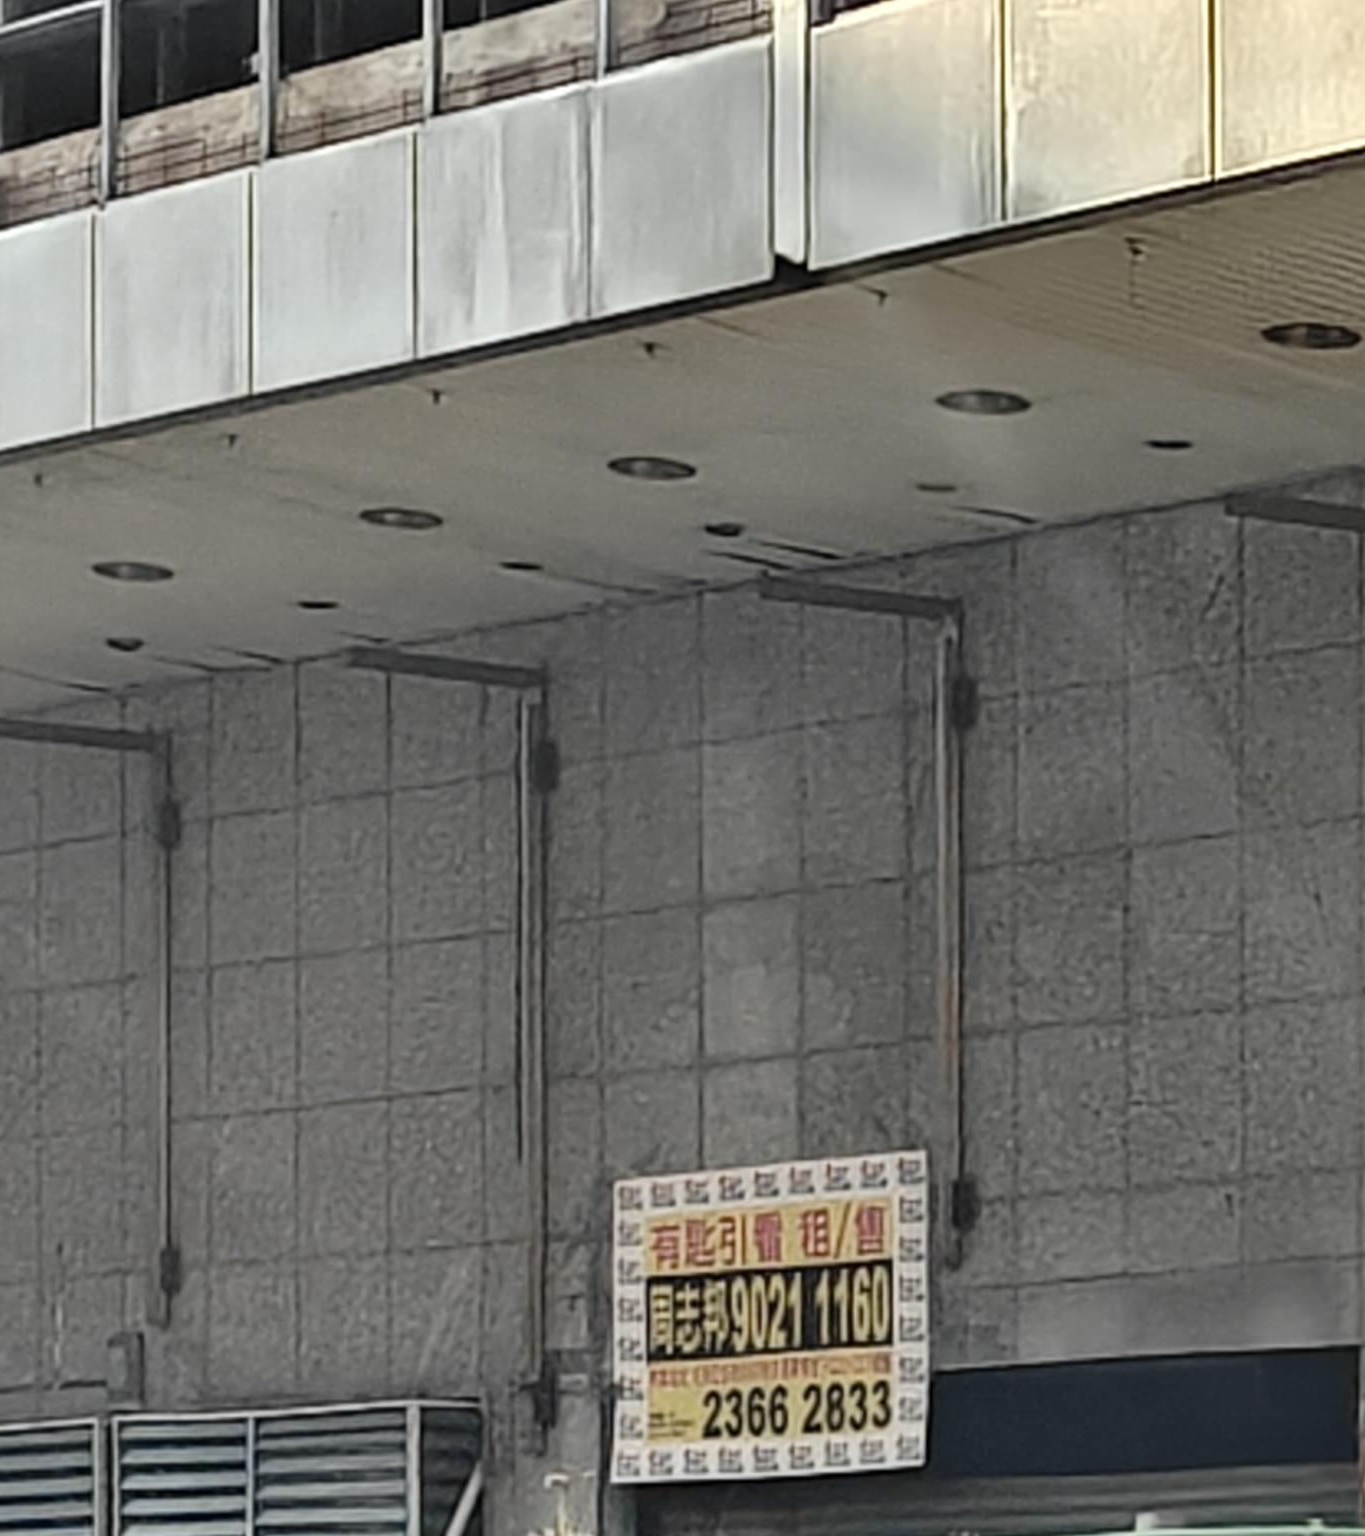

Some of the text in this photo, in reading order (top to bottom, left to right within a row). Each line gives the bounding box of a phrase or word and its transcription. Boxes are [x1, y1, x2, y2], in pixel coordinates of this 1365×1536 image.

[815, 1263, 891, 1347] 1160
[701, 1384, 790, 1440] 2366
[802, 1379, 893, 1434] 2833
